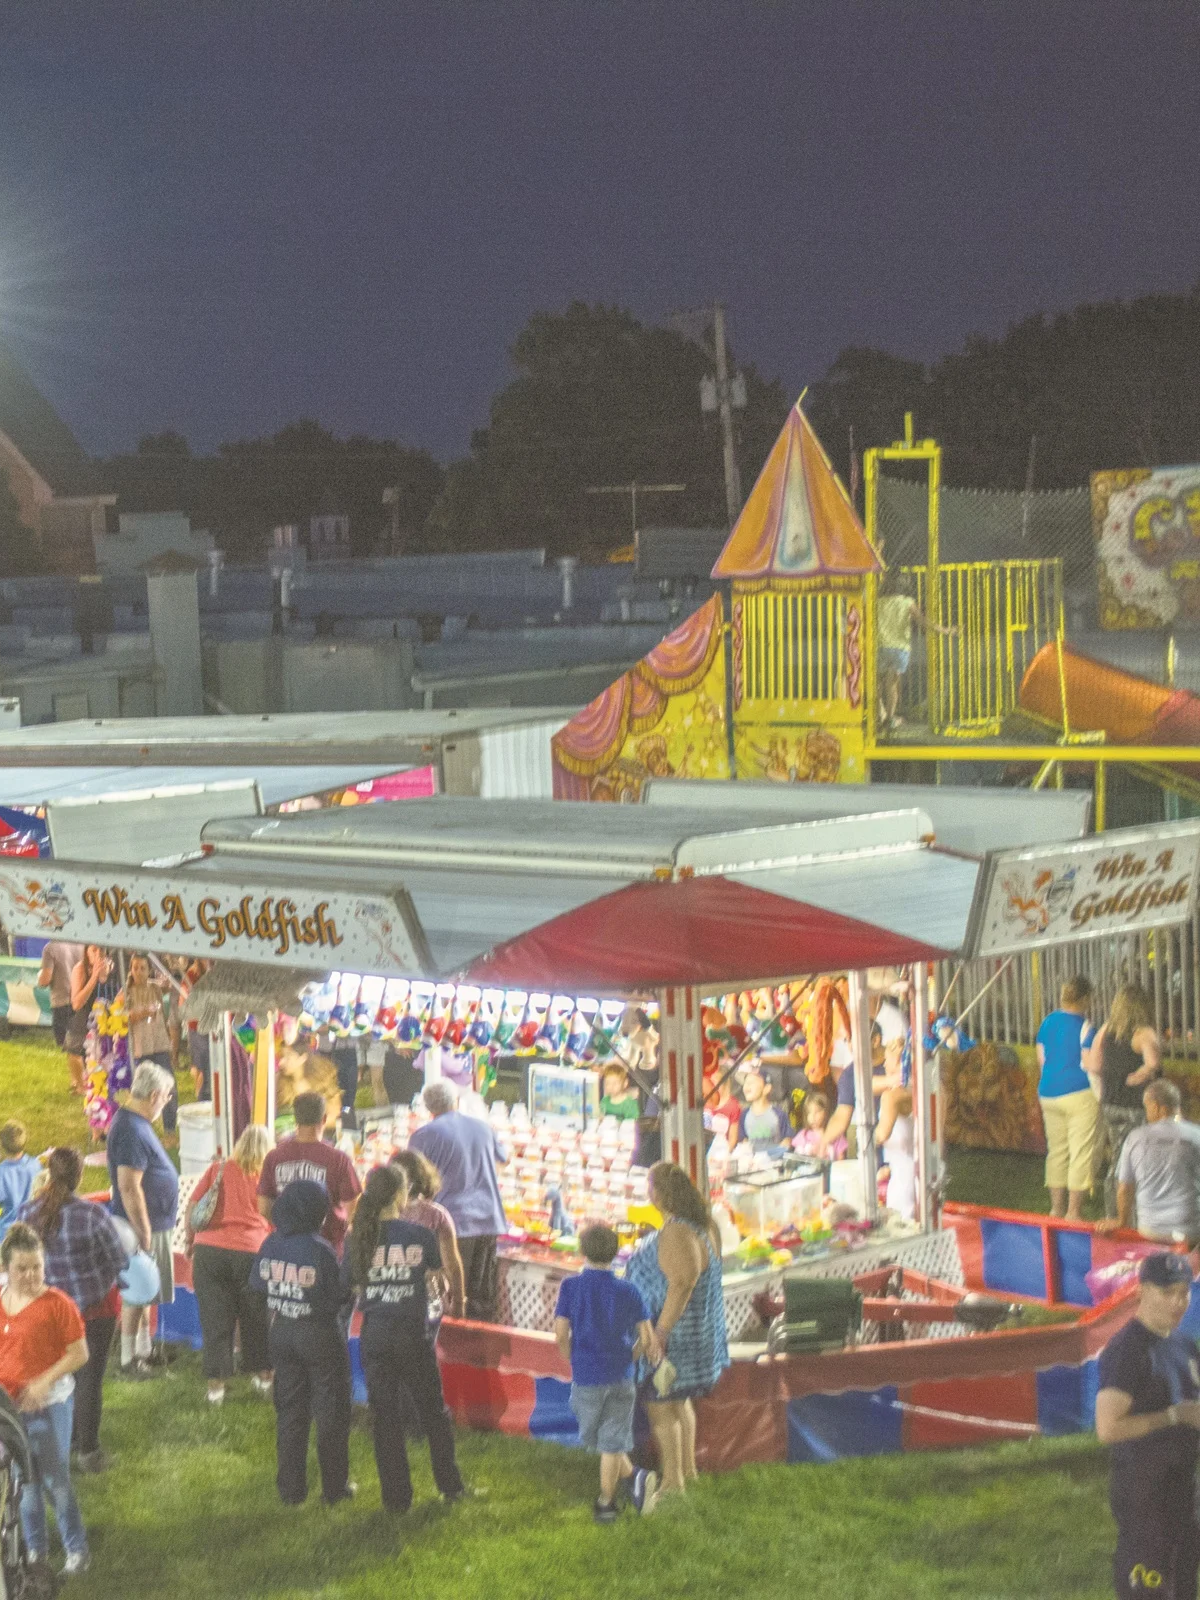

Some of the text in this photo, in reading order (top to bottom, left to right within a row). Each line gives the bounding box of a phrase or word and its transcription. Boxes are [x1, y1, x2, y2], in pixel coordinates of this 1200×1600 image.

[1093, 848, 1175, 882] Win A
[82, 884, 343, 956] Win A Goldfish
[1069, 873, 1191, 931] Goldfish
[268, 1279, 304, 1300] EMS
